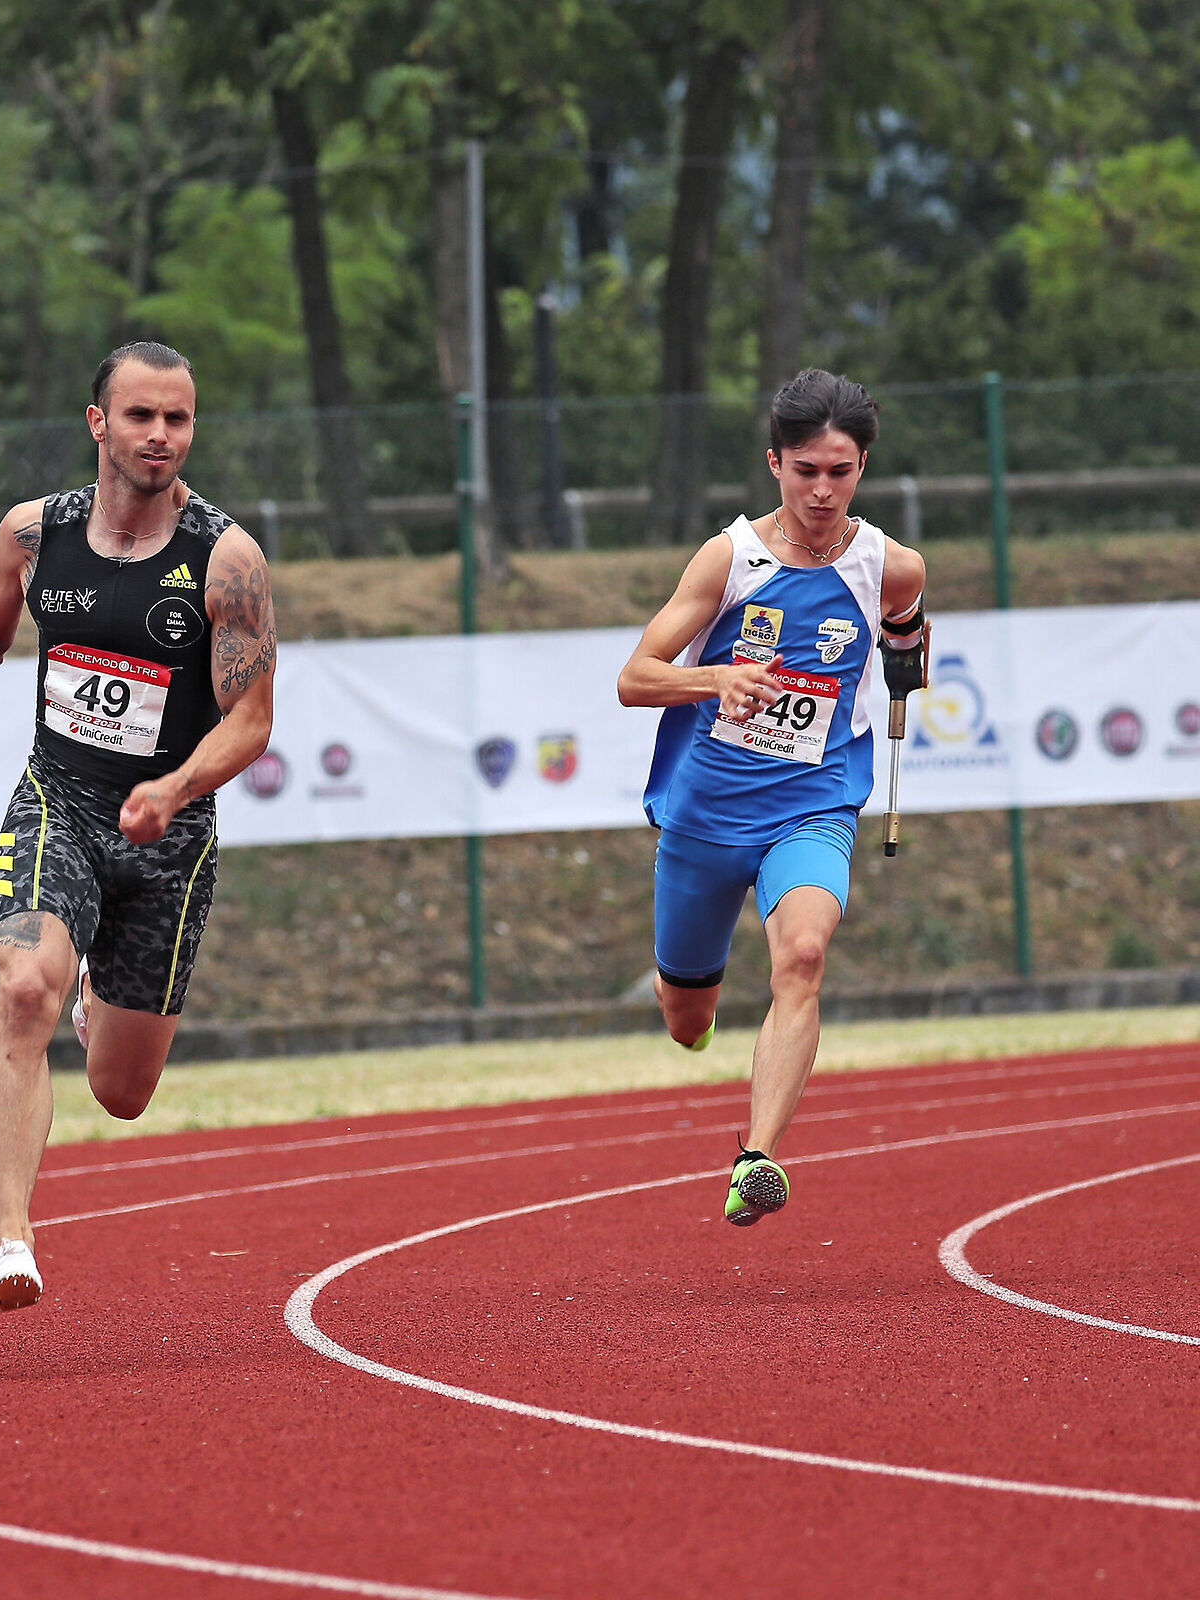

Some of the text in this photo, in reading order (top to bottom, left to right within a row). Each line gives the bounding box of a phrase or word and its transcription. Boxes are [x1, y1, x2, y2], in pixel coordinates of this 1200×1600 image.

[159, 577, 198, 590] adidas
[41, 589, 73, 602] ELITE
[40, 600, 76, 613] VEJLE
[169, 611, 183, 619] FOR
[166, 619, 186, 627] EMMA
[743, 628, 777, 641] TIGROS
[55, 648, 159, 679] OLTREMODOLTRE
[73, 674, 131, 718] 49
[93, 718, 120, 730] 2021
[79, 725, 124, 746] UniCredit
[754, 736, 796, 754] UniCredit
